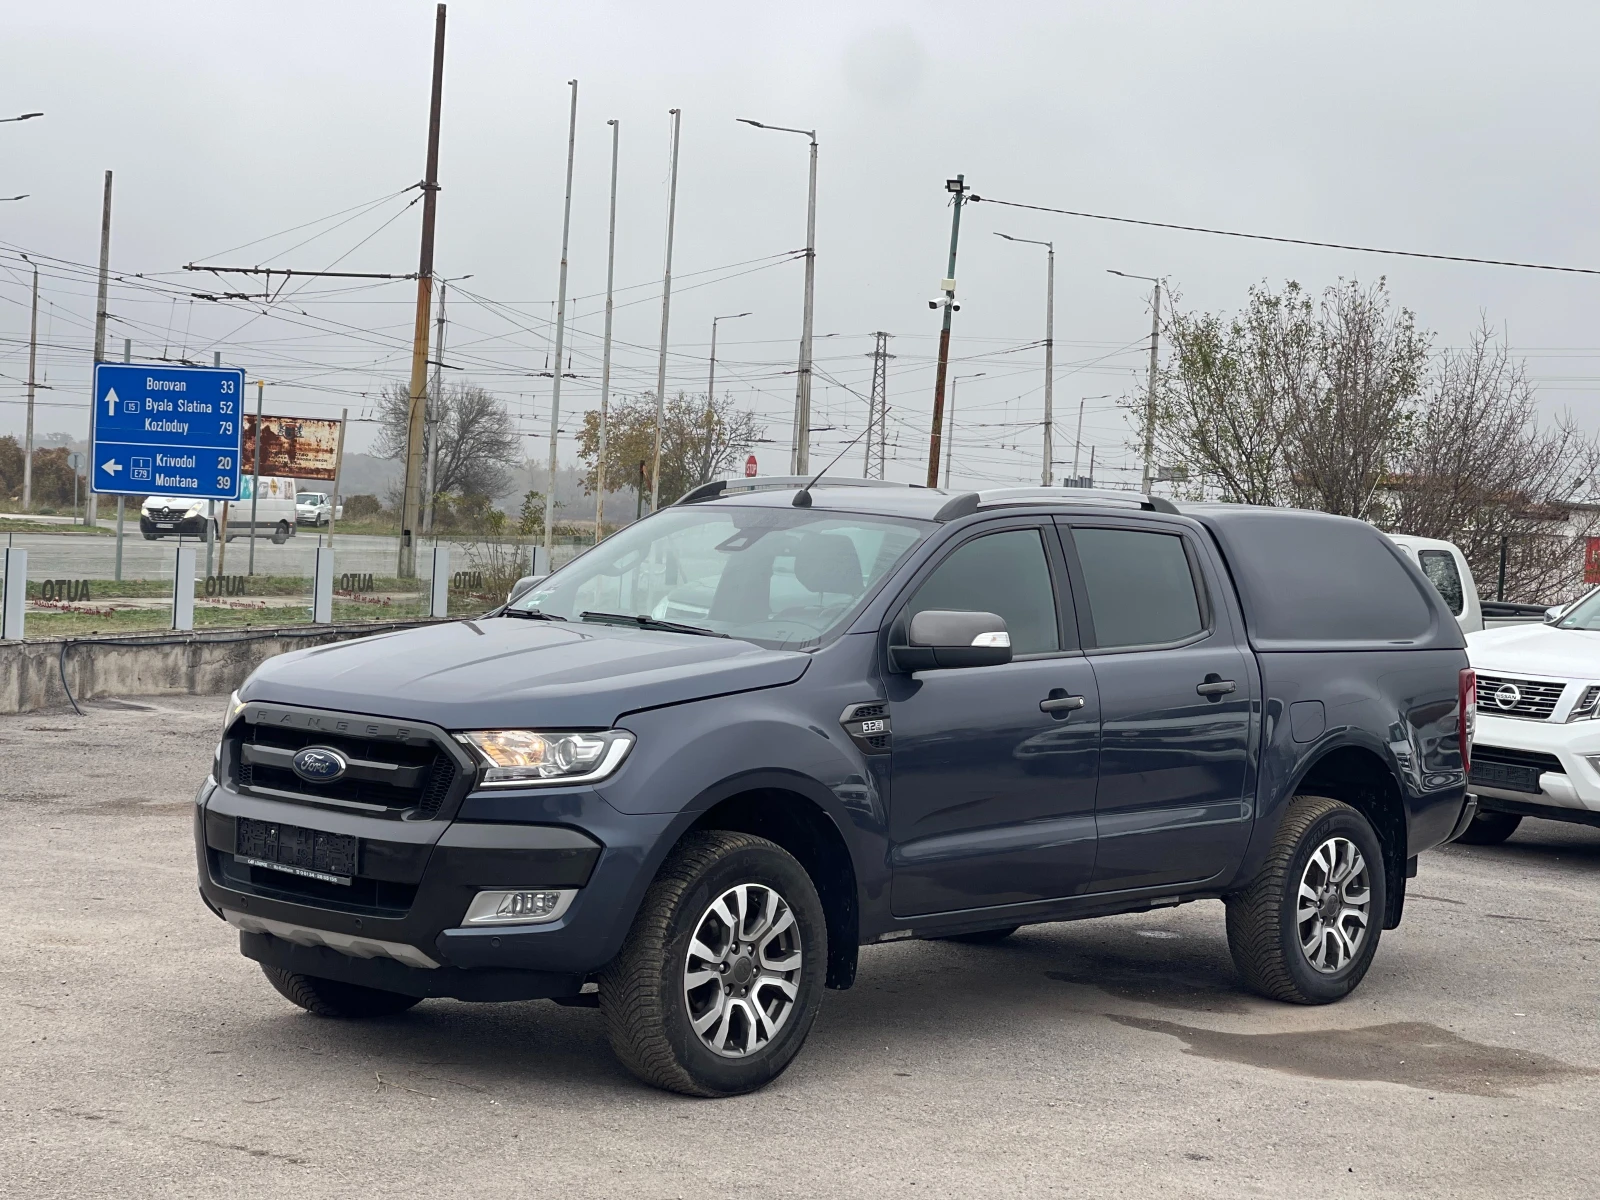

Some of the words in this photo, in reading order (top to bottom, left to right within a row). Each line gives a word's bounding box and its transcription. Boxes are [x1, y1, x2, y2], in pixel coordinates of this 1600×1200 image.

[146, 377, 187, 392] Borovan
[220, 381, 235, 394] 33
[128, 403, 136, 411] 15
[145, 398, 173, 413] Byala
[177, 400, 212, 413] Slatina
[219, 402, 233, 414] 52
[144, 418, 189, 436] Kozloduy
[219, 422, 233, 435] 79
[156, 454, 196, 468] Krivodol
[217, 457, 232, 470] 20
[746, 463, 757, 475] STOP
[134, 470, 148, 478] E79
[155, 474, 198, 488] Montana
[216, 476, 231, 489] 39
[256, 710, 411, 740] RANGER
[301, 753, 329, 773] Ford
